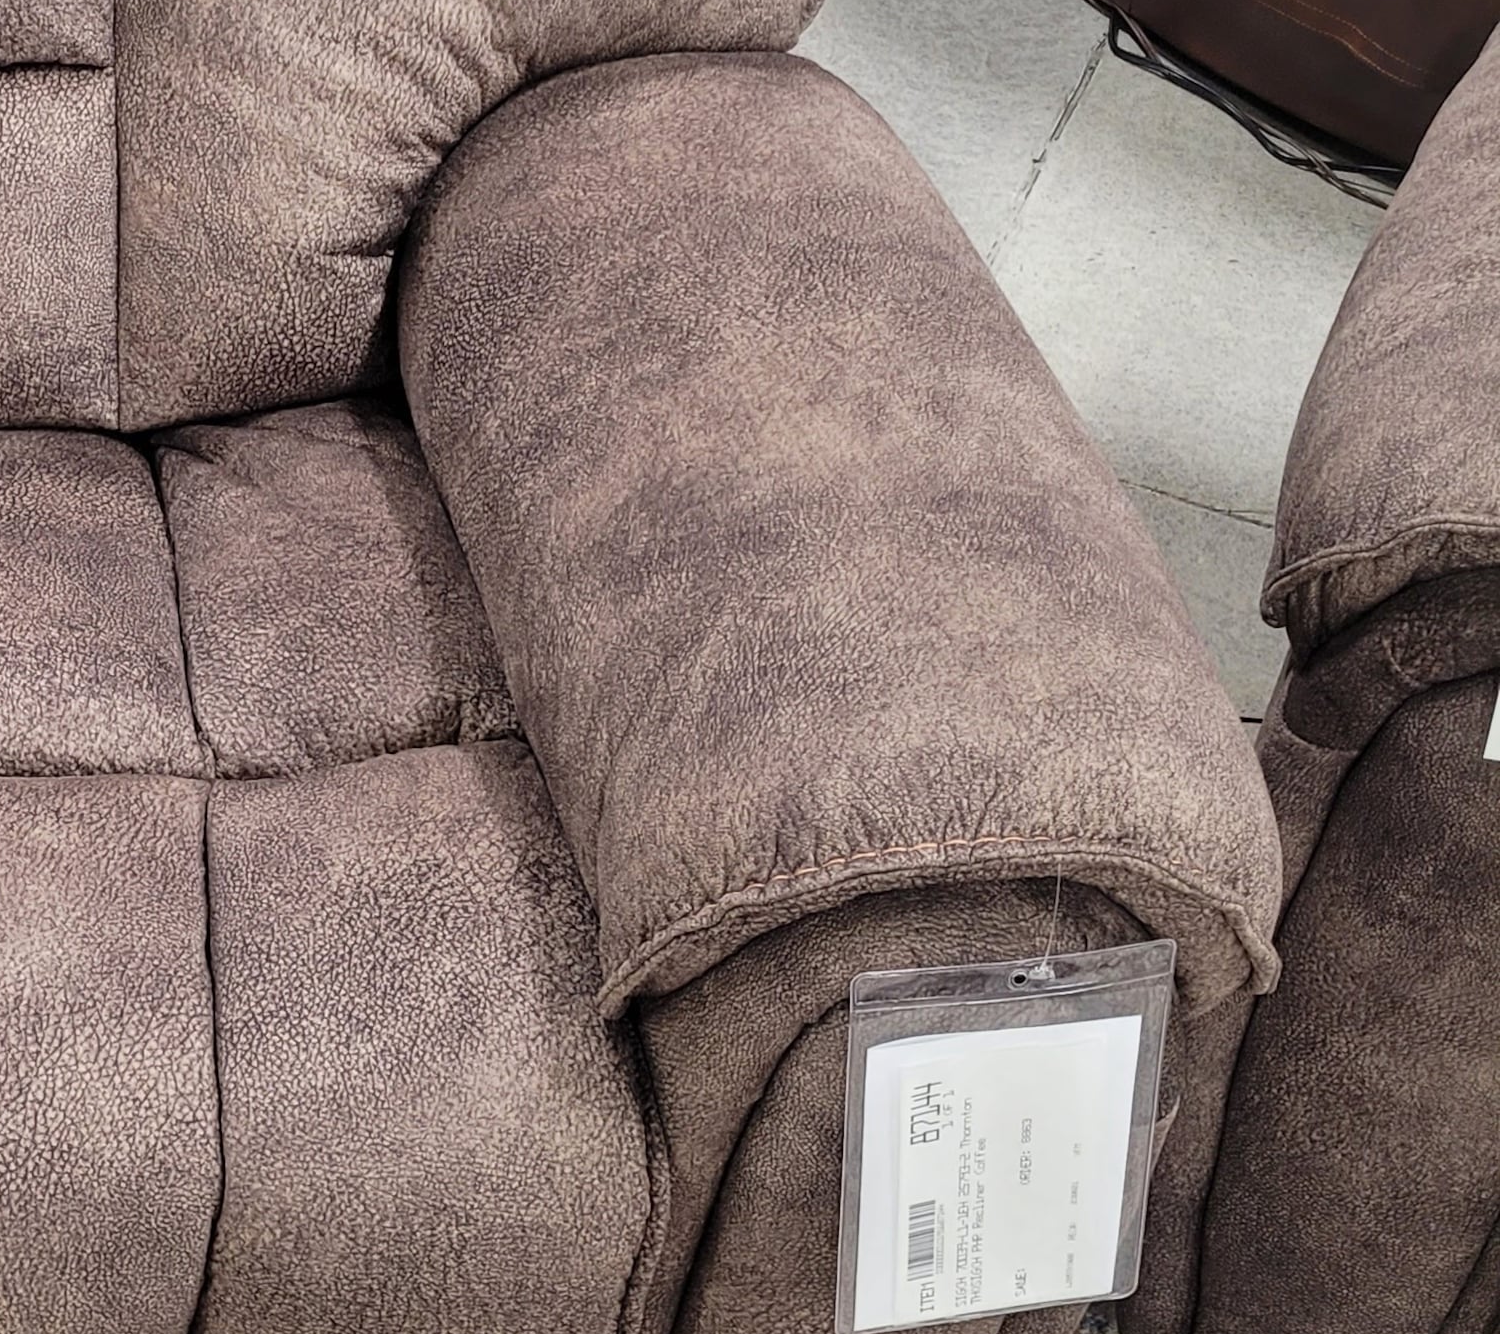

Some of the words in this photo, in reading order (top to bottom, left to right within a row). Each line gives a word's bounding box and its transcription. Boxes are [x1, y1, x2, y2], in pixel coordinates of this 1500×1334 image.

[910, 1082, 942, 1145] 87144
[959, 1097, 972, 1148] Thornton
[974, 1138, 986, 1175] Coffee
[972, 1181, 985, 1229] Recliner
[919, 1281, 935, 1313] ITEM
